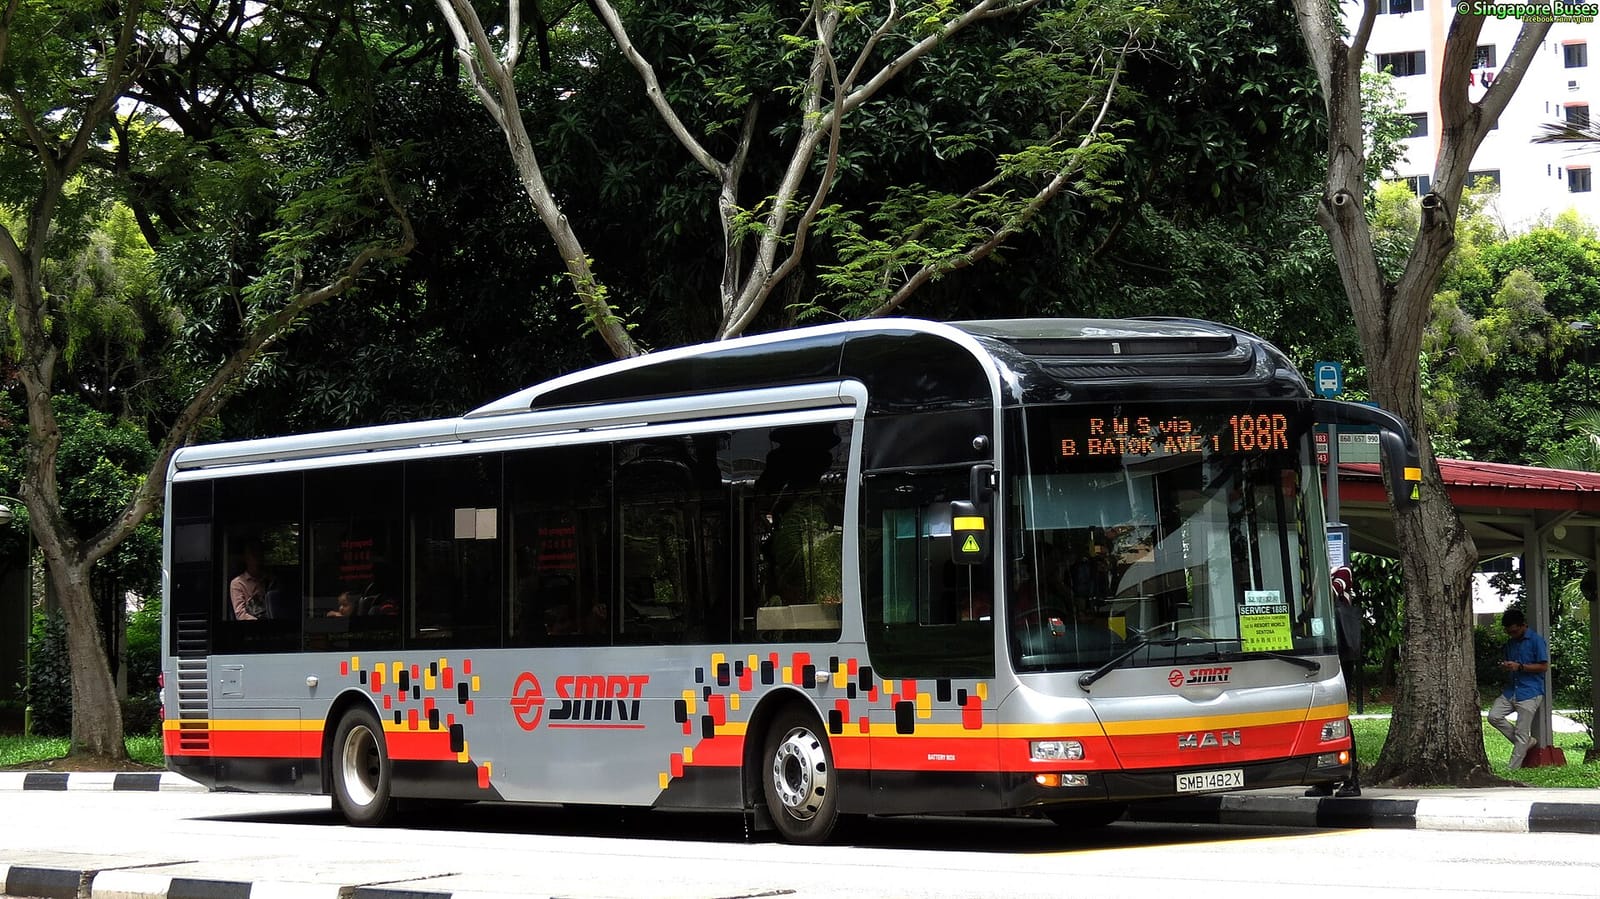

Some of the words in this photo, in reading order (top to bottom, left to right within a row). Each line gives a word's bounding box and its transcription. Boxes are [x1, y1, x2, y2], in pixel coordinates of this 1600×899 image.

[1090, 418, 1104, 435] R
[1113, 418, 1128, 434] W
[1137, 417, 1151, 434] S
[1159, 416, 1191, 433] via
[1229, 414, 1288, 450] 188R
[1061, 439, 1080, 456] B.
[1087, 437, 1154, 455] BATOK
[1164, 435, 1202, 453] AVE
[1211, 435, 1219, 451] 1
[1240, 607, 1270, 615] SERVICE
[1187, 667, 1232, 683] SMRT
[549, 675, 649, 720] SMRT
[1178, 731, 1241, 750] MAN
